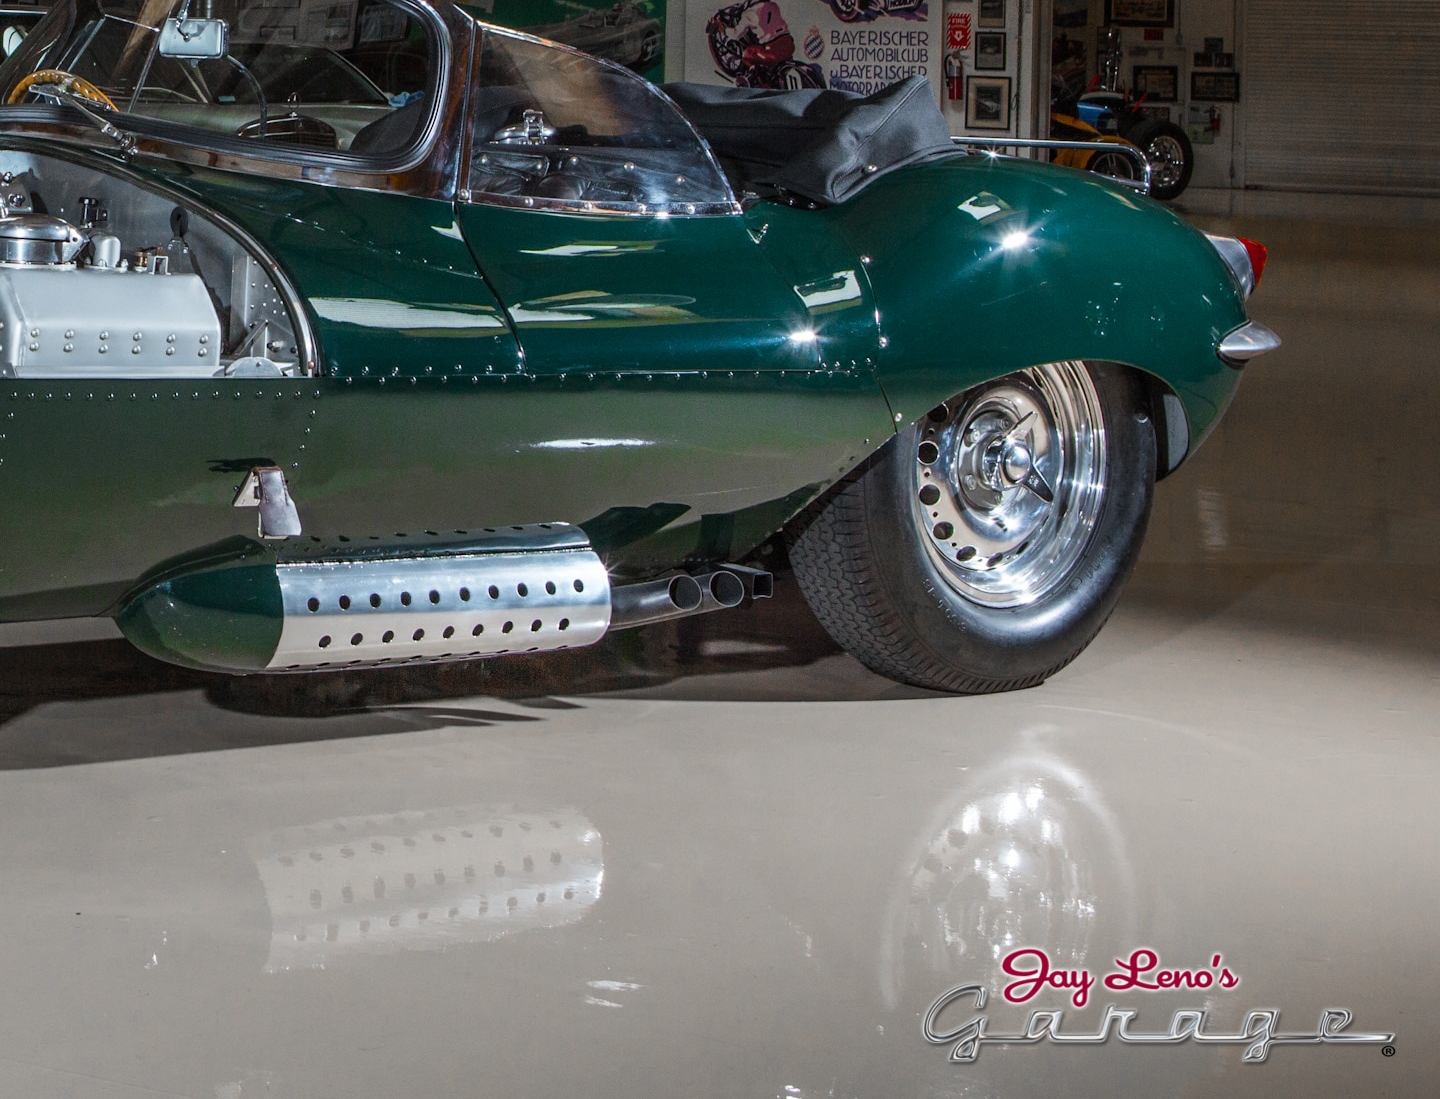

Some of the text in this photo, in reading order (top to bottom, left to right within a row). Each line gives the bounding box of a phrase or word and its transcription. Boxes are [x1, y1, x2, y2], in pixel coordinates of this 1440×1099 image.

[951, 17, 966, 25] FIRE
[830, 30, 929, 46] BAYERISCHER
[830, 47, 929, 63] AUTOMOBILCLUB
